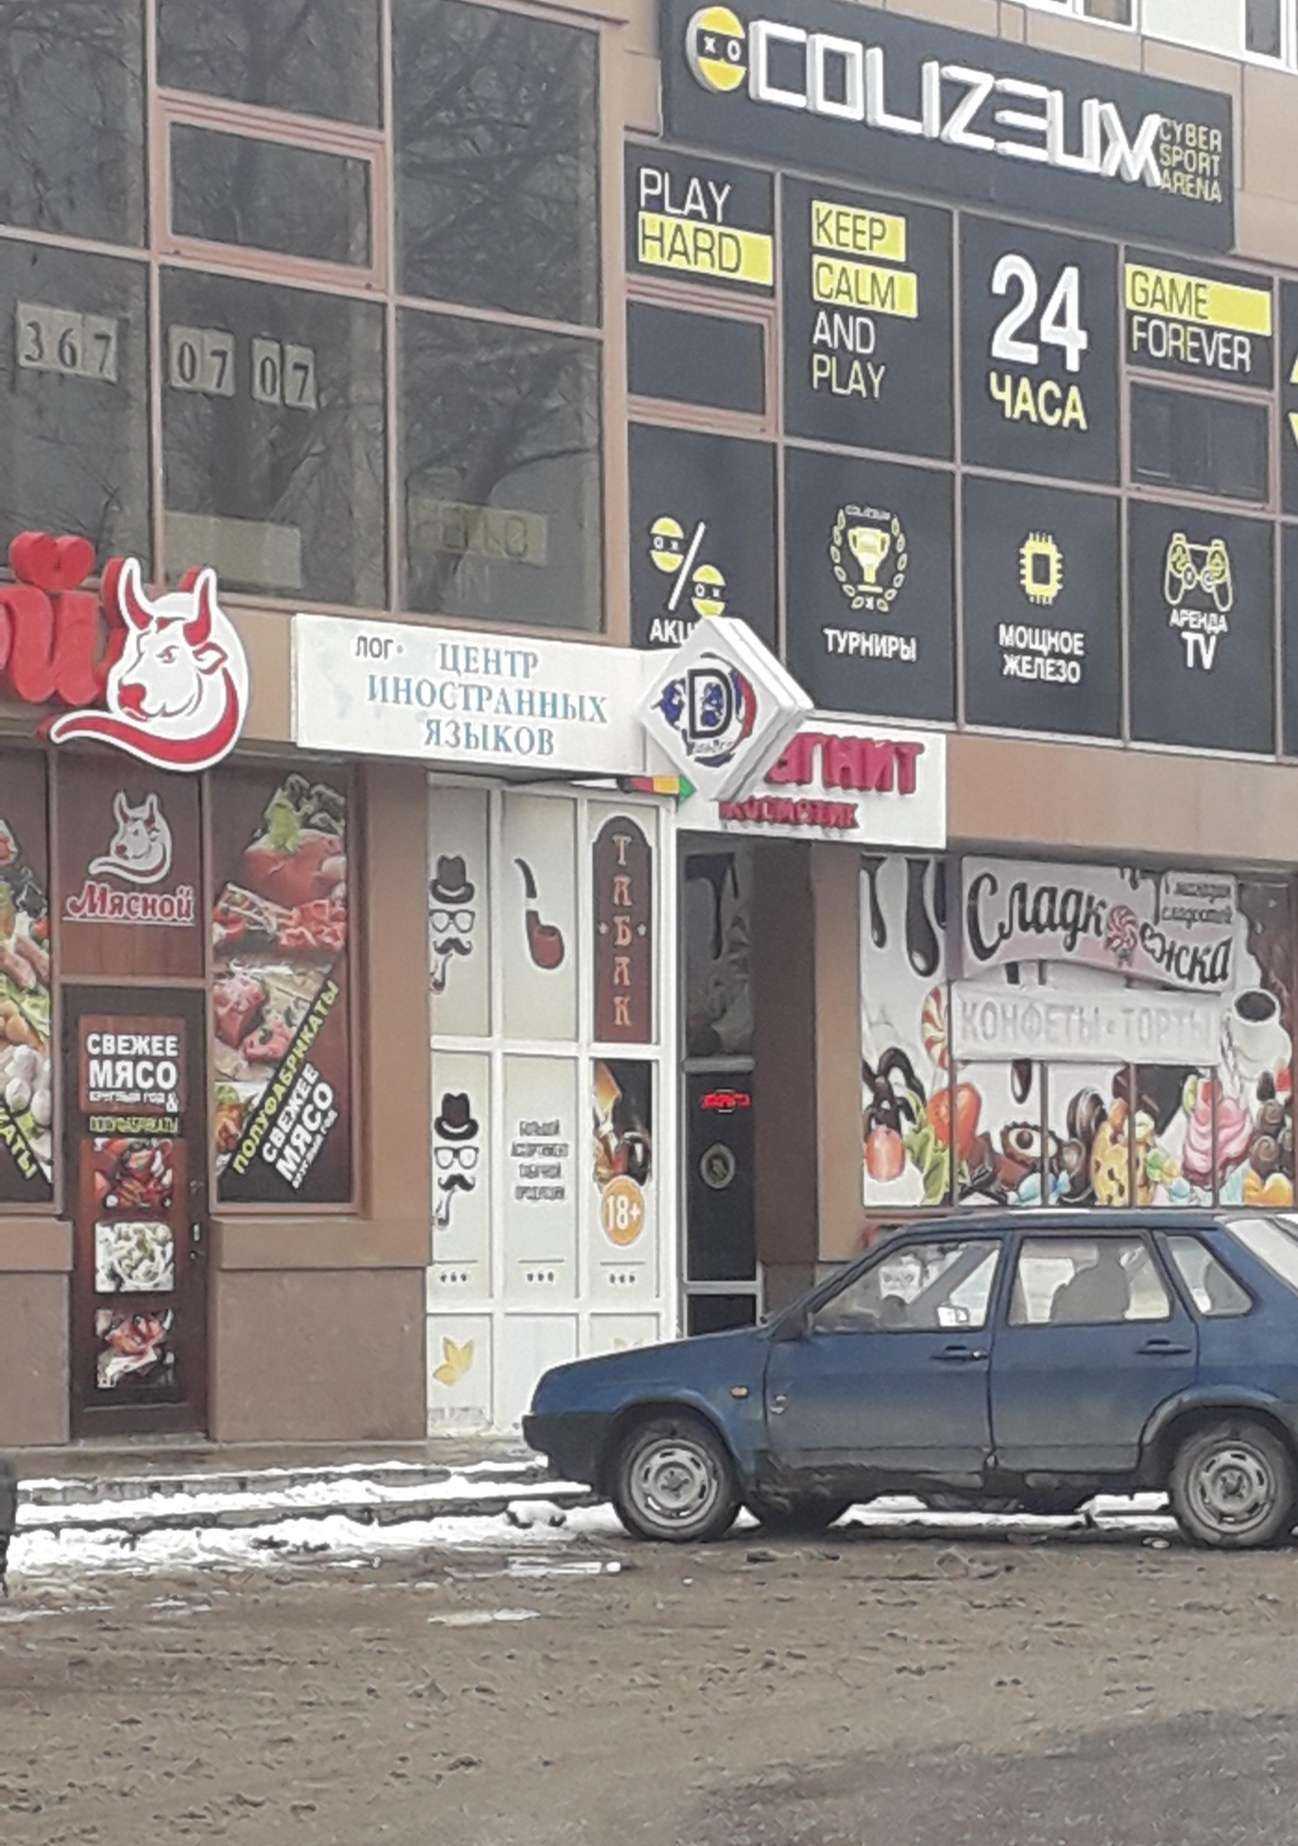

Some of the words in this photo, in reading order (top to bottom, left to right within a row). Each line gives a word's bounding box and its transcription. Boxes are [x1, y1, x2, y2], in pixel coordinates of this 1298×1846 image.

[748, 20, 1161, 188] COLIZEUM
[1159, 117, 1222, 153] CYBER
[1159, 142, 1221, 178] SPORT
[639, 166, 732, 224] PLAY
[1160, 168, 1222, 203] ARENA
[640, 217, 743, 275] HARD
[814, 207, 888, 252] KEEP
[814, 262, 897, 311] CALM
[1131, 270, 1209, 319] GAME
[812, 310, 876, 355] AND
[991, 252, 1088, 373] 24
[24, 320, 111, 369] 367
[1132, 320, 1252, 373] FOREVER
[176, 342, 230, 380] 07
[259, 355, 311, 397] 07
[812, 353, 886, 400] PLAY
[988, 369, 1087, 432] ЧАСА
[999, 622, 1085, 655] МОЩНОЕ
[1170, 607, 1229, 634] АРЕНДА
[438, 643, 539, 679] ЦЕНТР
[823, 627, 917, 662] ТУРНИРЫ
[1180, 632, 1218, 670] TV
[1001, 652, 1082, 684] ЖЕЛЕЗО
[367, 674, 608, 724] ИНОСТРАННЫХ
[424, 719, 555, 756] ЯЗЫКОВ
[960, 1000, 1100, 1042] КОНФЕТЫ
[87, 1034, 179, 1057] СВЕЖЕЕ
[88, 1060, 177, 1090] МЯСО
[232, 979, 340, 1176] ПОЛУФАБРИКАТЫ
[262, 1062, 320, 1164] СВЕЖЕЕ
[275, 1082, 334, 1182] МЯСО
[605, 1194, 641, 1231] 18+
